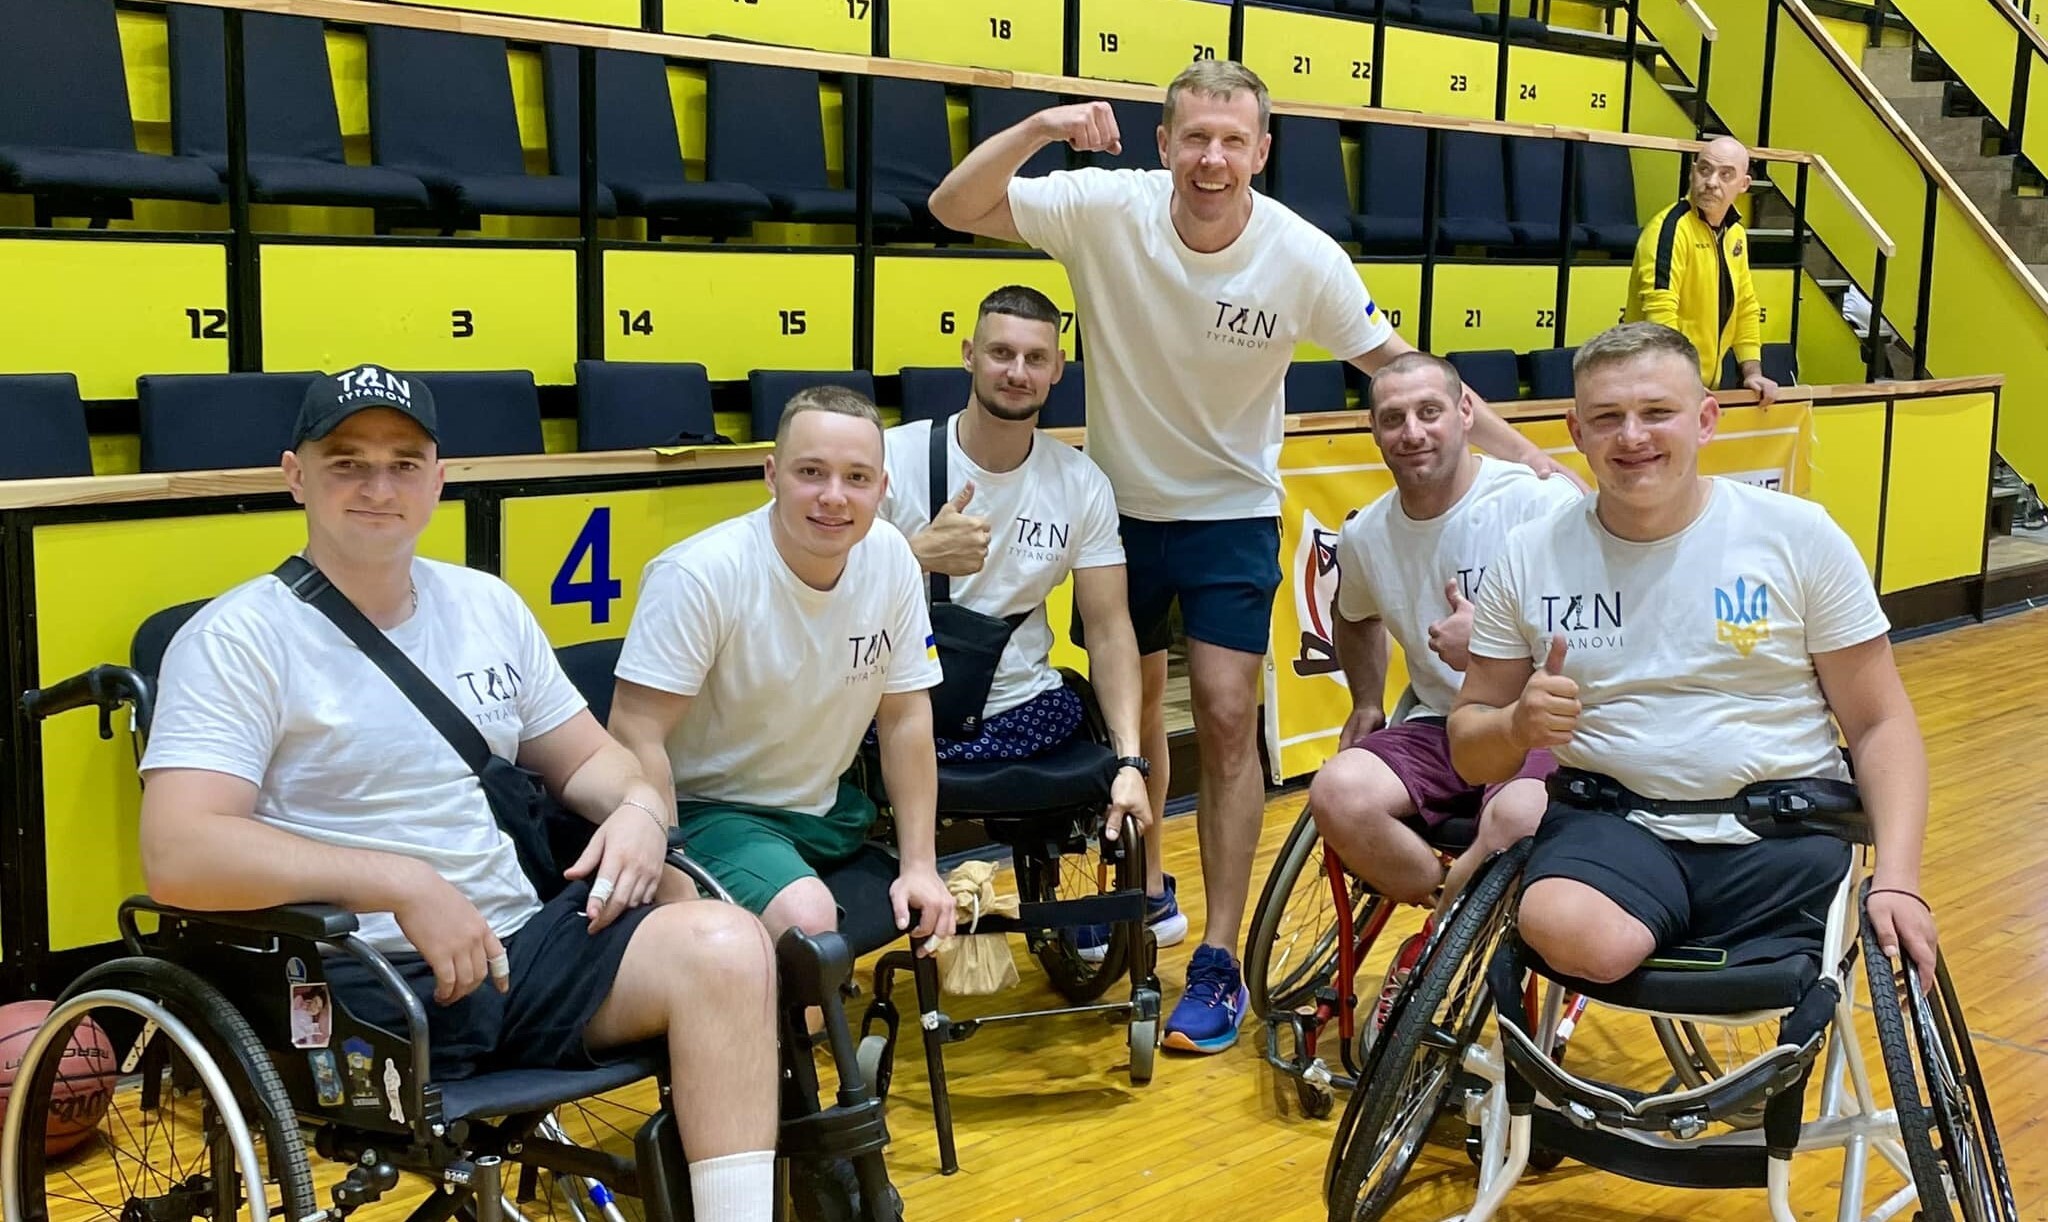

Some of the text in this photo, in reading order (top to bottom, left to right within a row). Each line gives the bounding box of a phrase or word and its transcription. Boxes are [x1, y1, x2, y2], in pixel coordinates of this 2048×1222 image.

[847, 0, 869, 19] 17
[990, 18, 1011, 39] 18
[1099, 33, 1118, 52] 19
[1294, 56, 1310, 74] 21
[1352, 61, 1371, 79] 22
[1450, 75, 1466, 91] 23
[1520, 84, 1536, 100] 24
[1591, 93, 1606, 108] 25
[186, 309, 227, 339] 12
[452, 310, 473, 337] 3
[619, 310, 653, 335] 14
[779, 311, 806, 335] 15
[941, 312, 955, 334] 6
[1061, 312, 1074, 334] 7
[1465, 310, 1481, 327] 21
[1536, 310, 1554, 327] 22
[1619, 307, 1626, 324] 2
[1759, 307, 1767, 323] 5
[1206, 331, 1269, 350] TYTANOVI
[337, 387, 412, 408] TYTANOVI
[551, 507, 622, 624] 4
